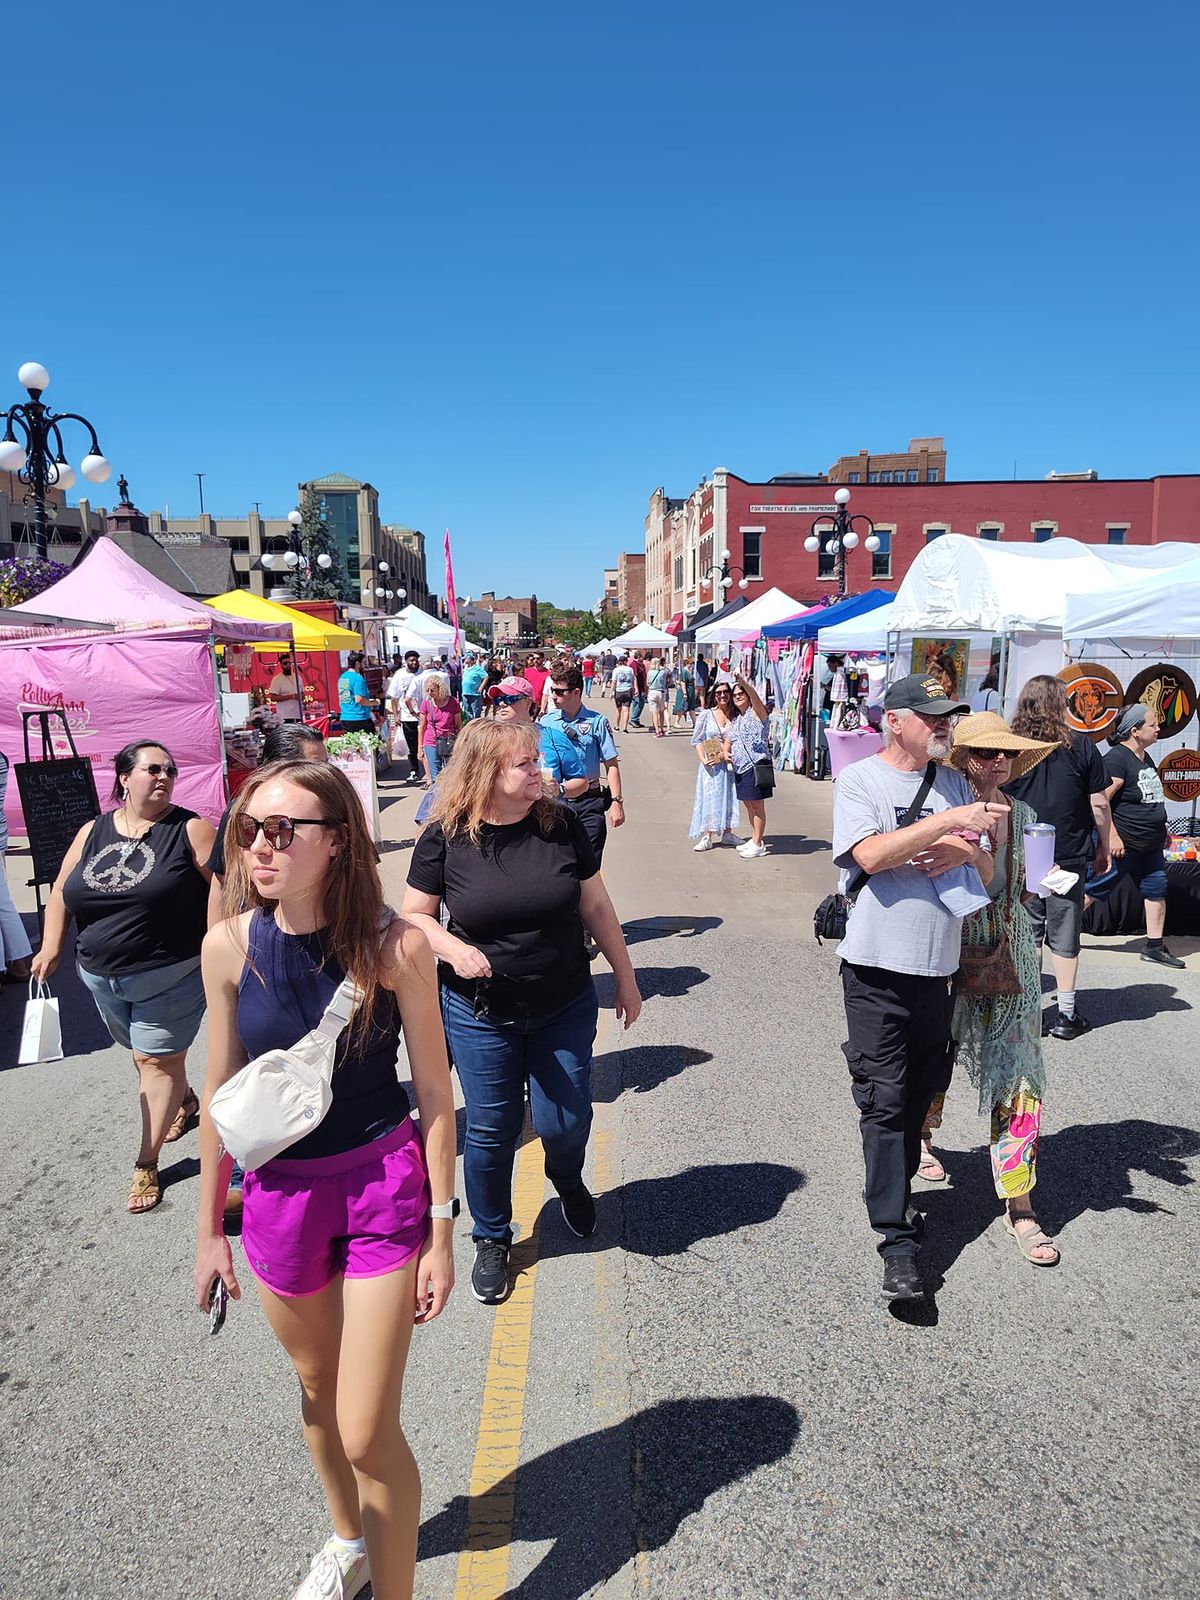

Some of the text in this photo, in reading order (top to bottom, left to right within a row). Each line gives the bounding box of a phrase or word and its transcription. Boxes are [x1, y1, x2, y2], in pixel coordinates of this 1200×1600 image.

[20, 682, 86, 712] Polly Ann
[1175, 758, 1200, 769] MOTOR
[1173, 783, 1198, 795] CYCLES
